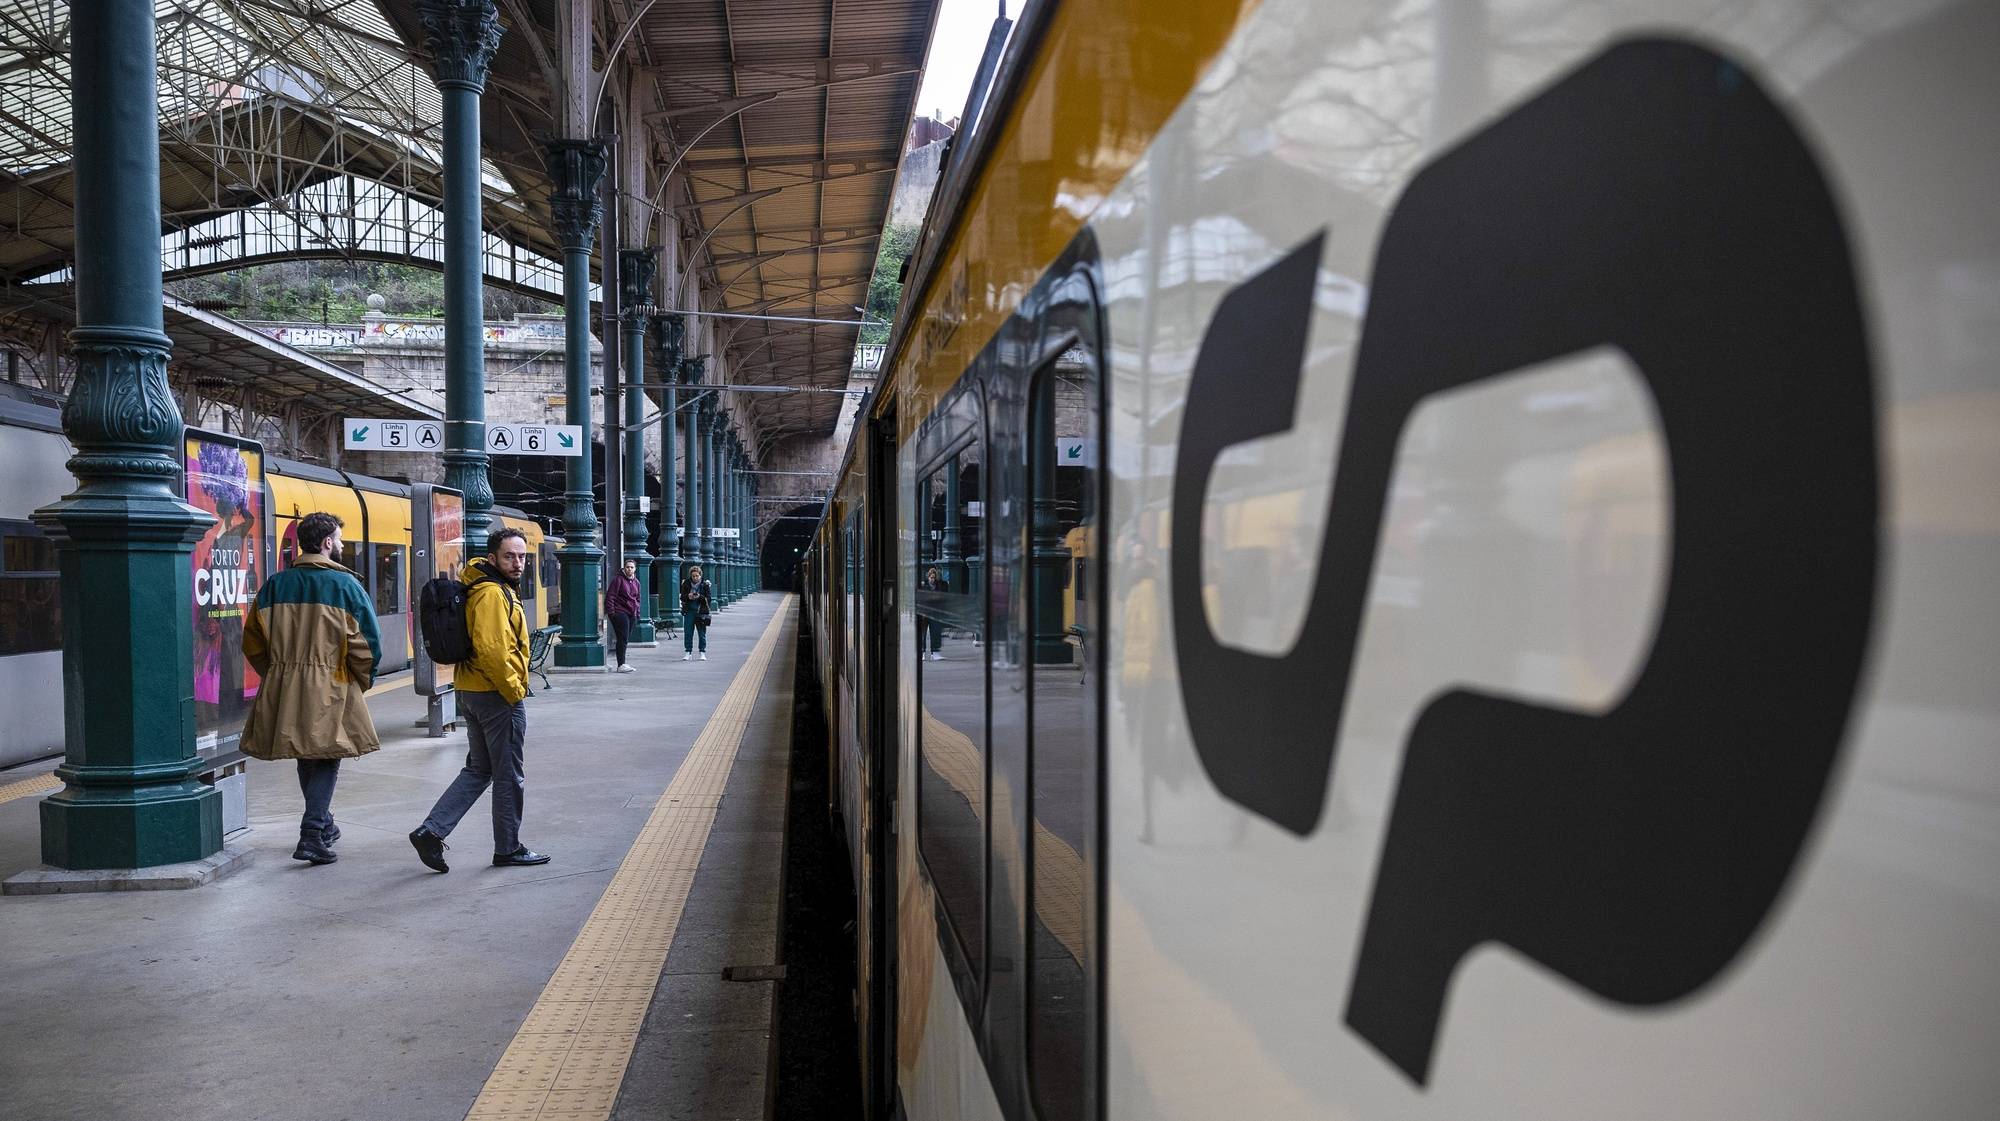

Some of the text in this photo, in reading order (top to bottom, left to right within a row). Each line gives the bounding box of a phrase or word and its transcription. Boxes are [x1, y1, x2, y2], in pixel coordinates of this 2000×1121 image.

[390, 429, 436, 446] 5 A
[494, 432, 539, 449] A 6
[211, 549, 241, 566] PORTO
[194, 568, 248, 606] CRUZ
